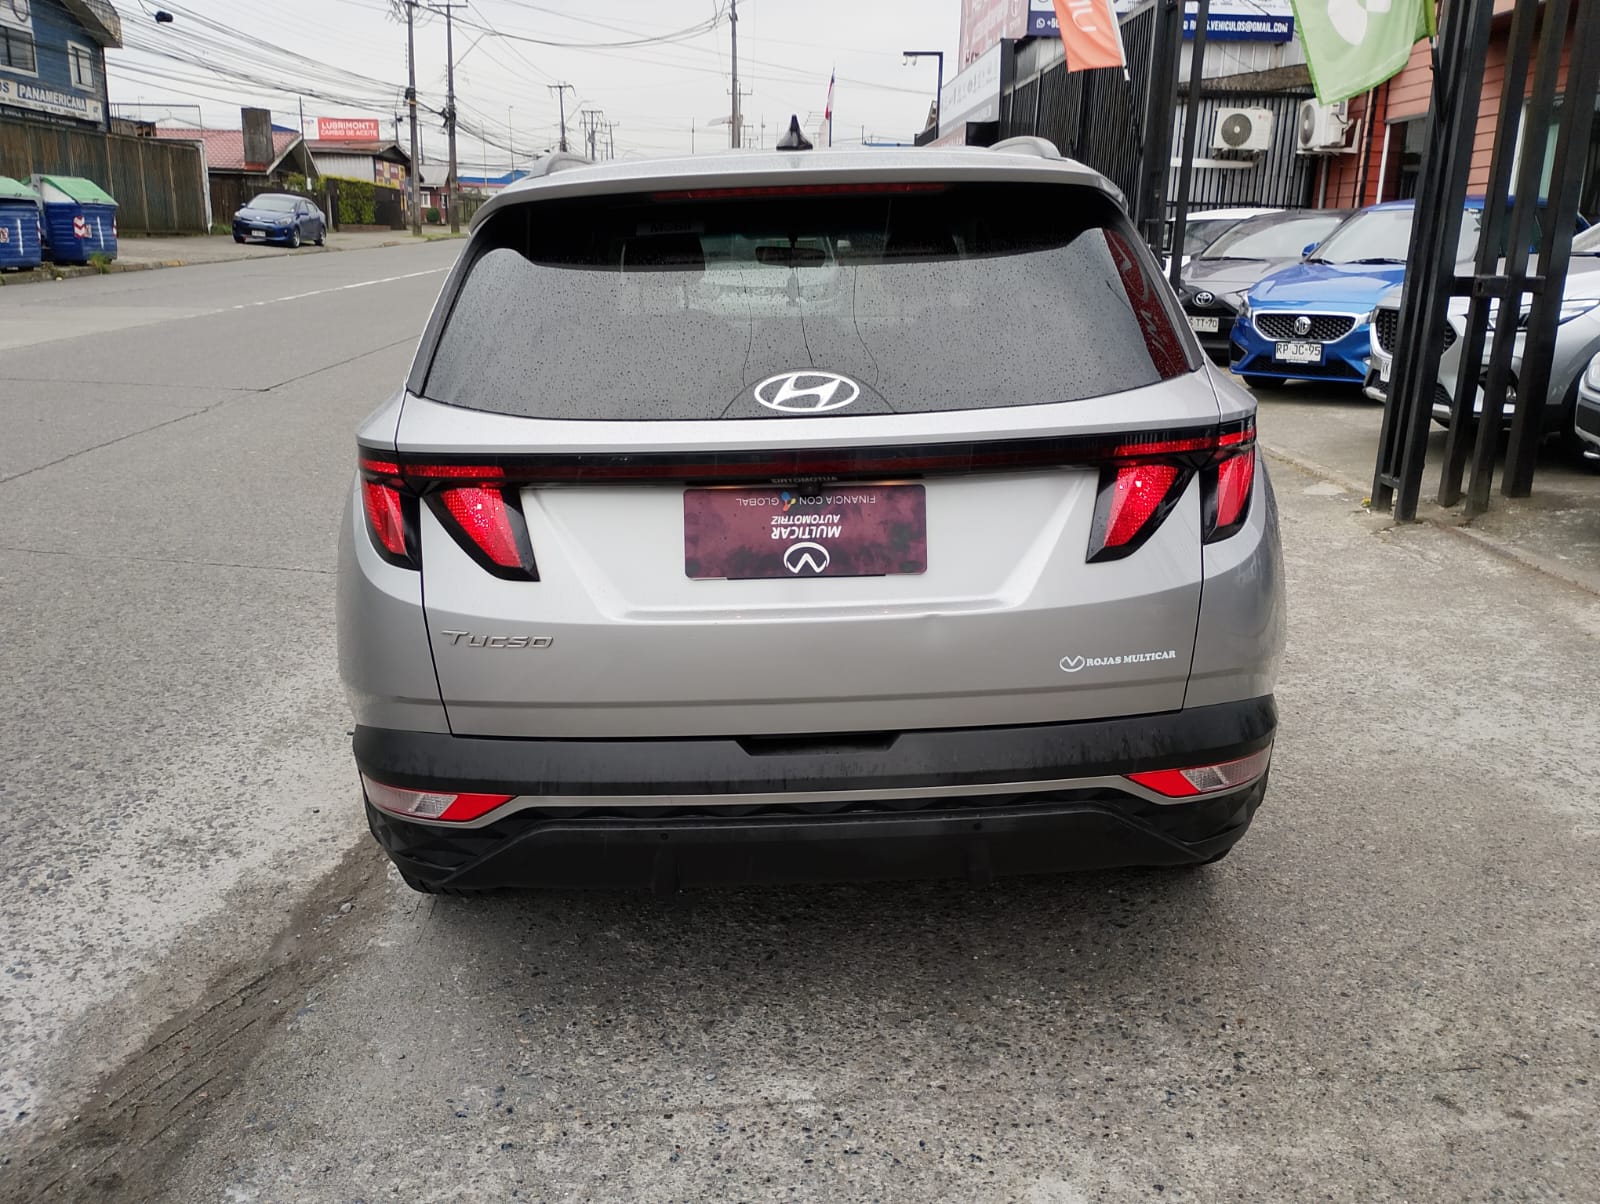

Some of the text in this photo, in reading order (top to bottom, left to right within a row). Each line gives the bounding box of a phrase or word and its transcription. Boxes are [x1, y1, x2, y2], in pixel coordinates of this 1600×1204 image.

[0, 80, 9, 93] S
[19, 83, 87, 111] PANAMERICANA
[320, 129, 345, 137] CAMBIO
[345, 129, 355, 137] DE
[735, 495, 876, 507] FINANCIA CON GLOBAL
[771, 514, 841, 525] AUTOMOTRIZ
[771, 525, 841, 540] MULTICAR
[1086, 650, 1176, 667] ROJAS MULTICAR
